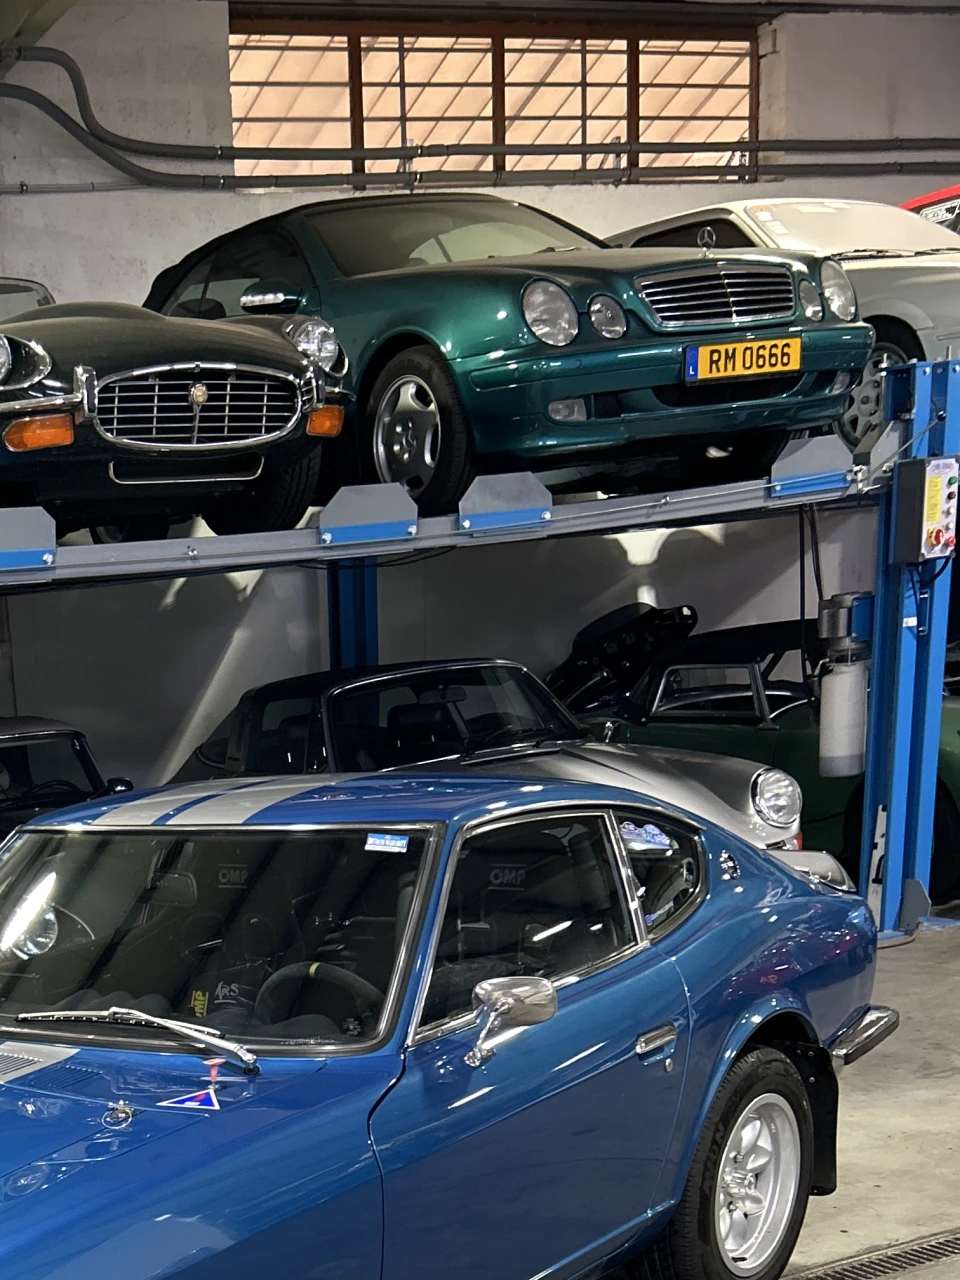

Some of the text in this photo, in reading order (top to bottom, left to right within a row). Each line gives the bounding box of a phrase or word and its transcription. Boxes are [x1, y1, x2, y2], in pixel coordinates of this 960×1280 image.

[709, 343, 791, 374] RM 0666
[689, 366, 695, 375] L
[218, 868, 248, 883] OMP
